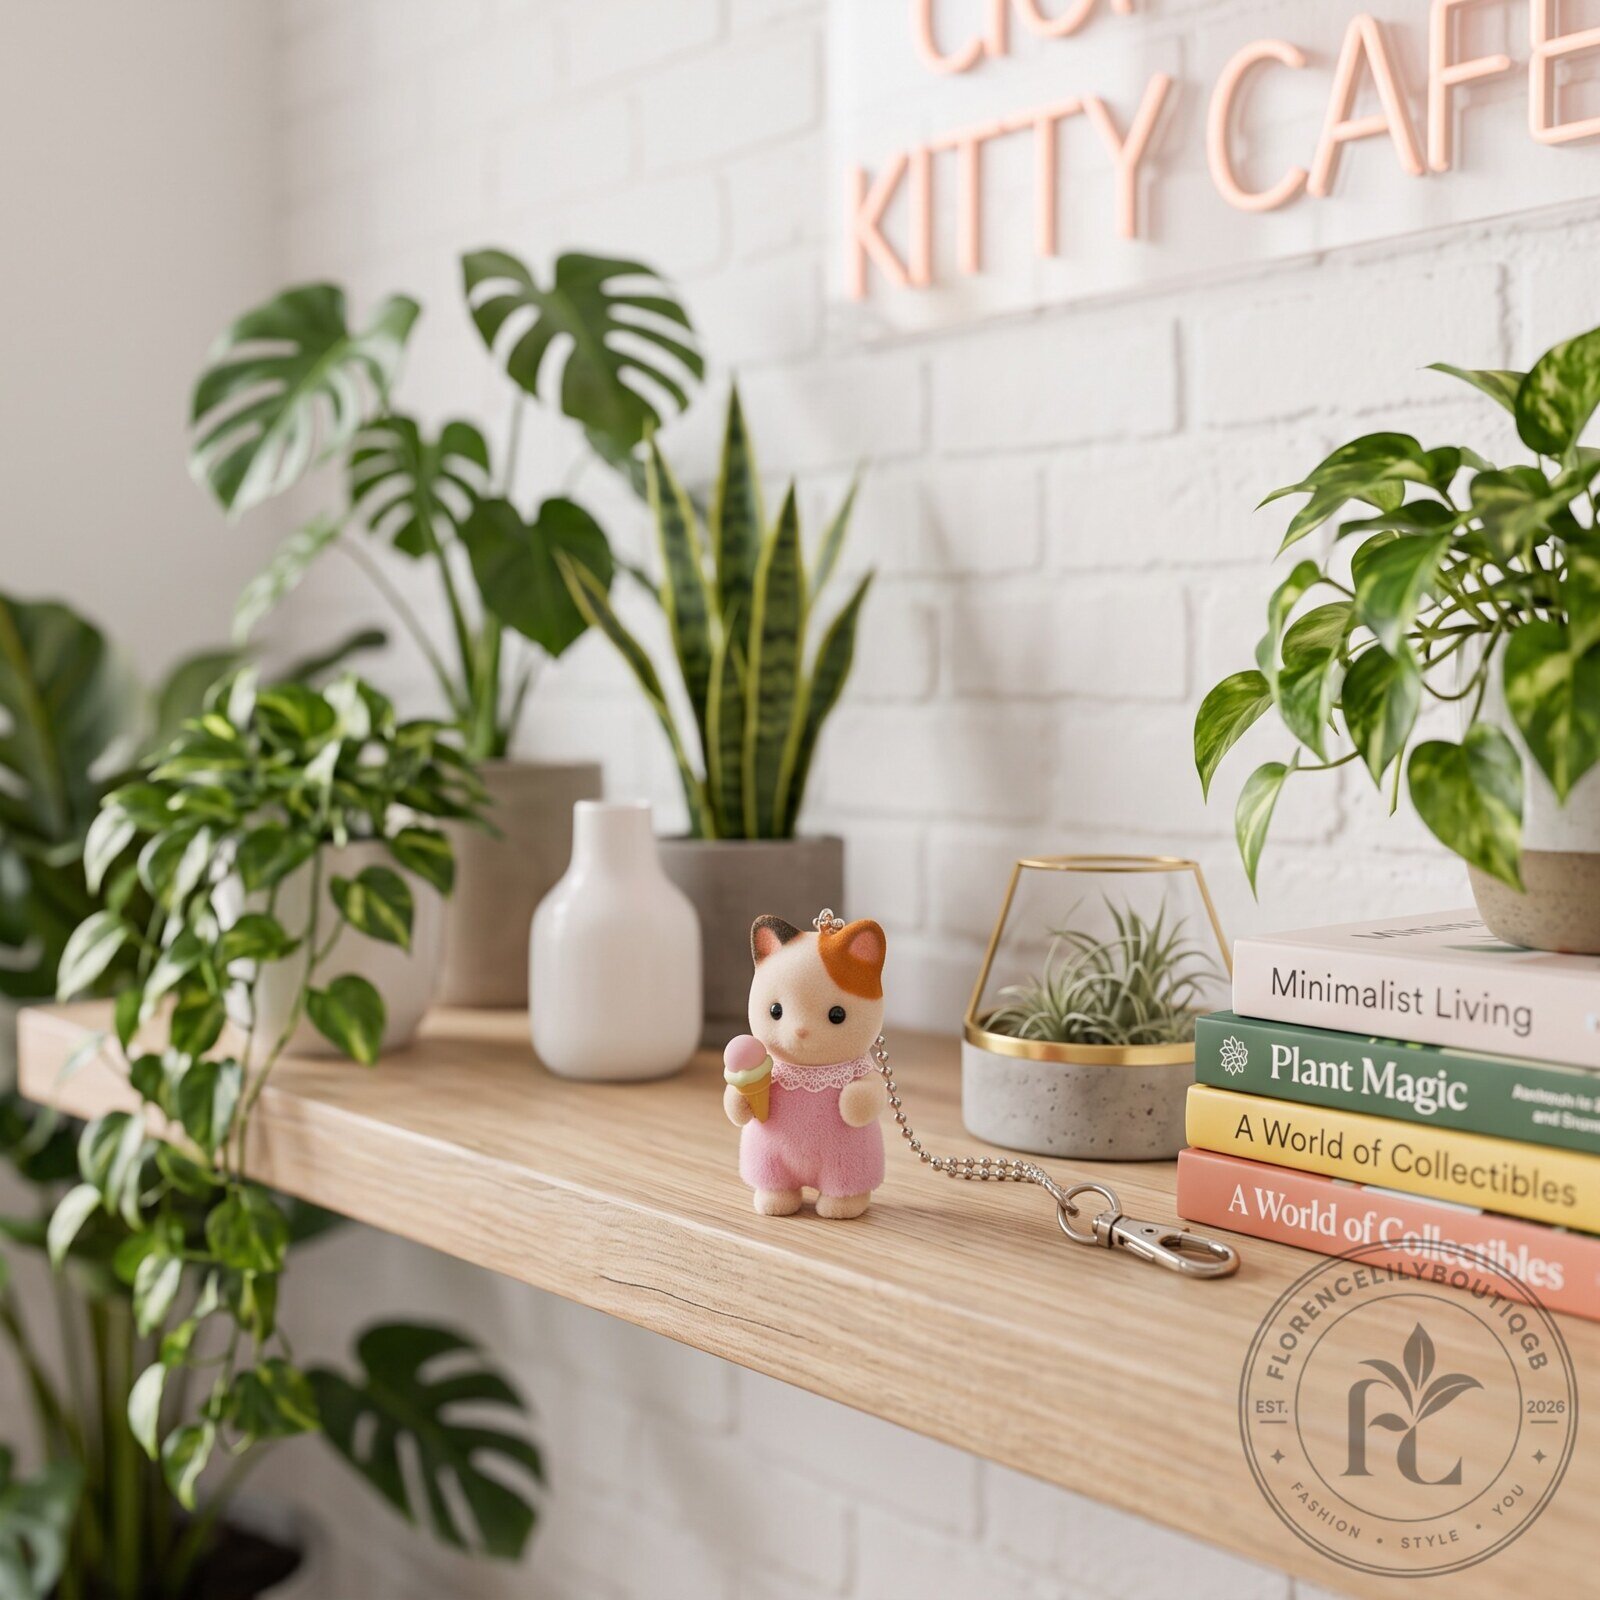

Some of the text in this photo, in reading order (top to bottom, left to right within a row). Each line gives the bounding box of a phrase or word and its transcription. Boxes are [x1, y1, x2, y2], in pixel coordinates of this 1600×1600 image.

[849, 0, 1600, 299] KITTY CAFE
[1271, 966, 1534, 1038] Minimalist Living
[1269, 1043, 1354, 1092] Plant
[1360, 1056, 1469, 1115] Magic
[1234, 1113, 1578, 1208] A World of Collectibles
[1227, 1183, 1565, 1292] A World of Collectibles
